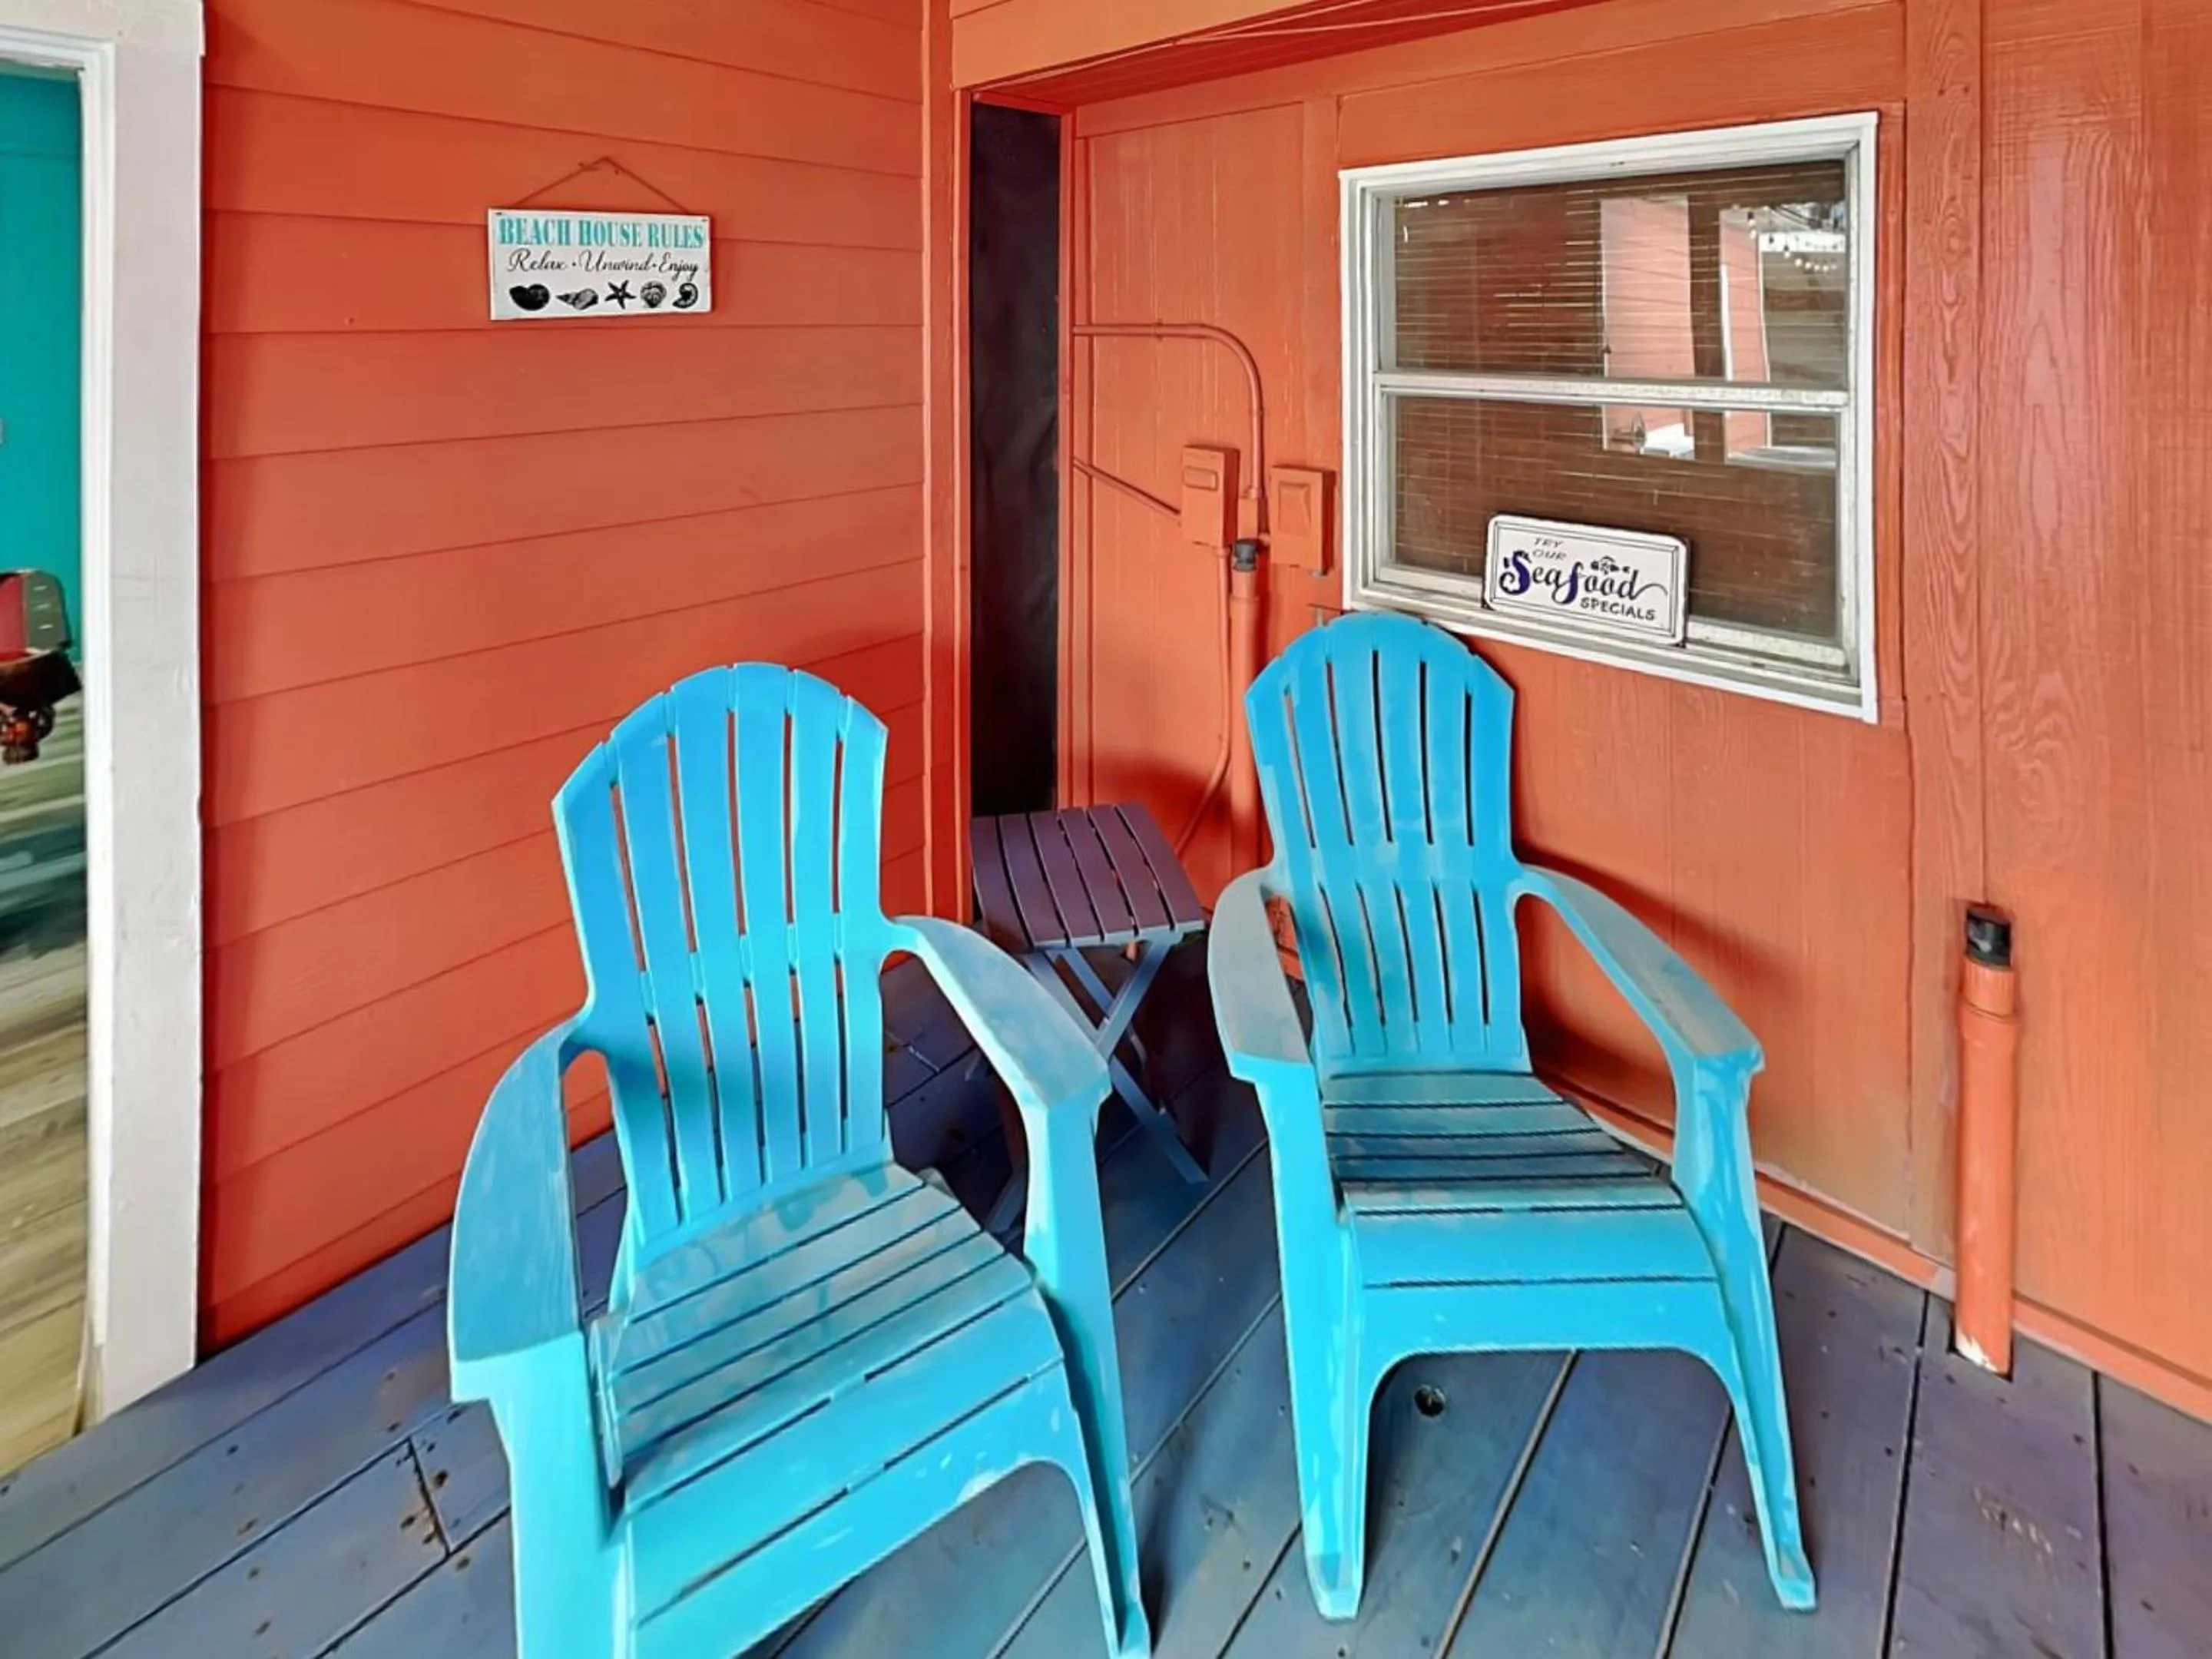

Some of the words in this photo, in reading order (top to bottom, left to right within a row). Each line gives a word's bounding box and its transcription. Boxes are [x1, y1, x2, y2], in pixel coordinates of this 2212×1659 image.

[499, 217, 571, 246] BEACH
[578, 220, 642, 247] HOUSE
[647, 223, 704, 249] RULES
[507, 247, 567, 272] Relax
[578, 250, 654, 272] Unwind
[658, 252, 700, 282] Enjoy
[1532, 548, 1568, 561] OUR
[1534, 538, 1563, 547] TRY
[1580, 597, 1657, 621] SPECIALS
